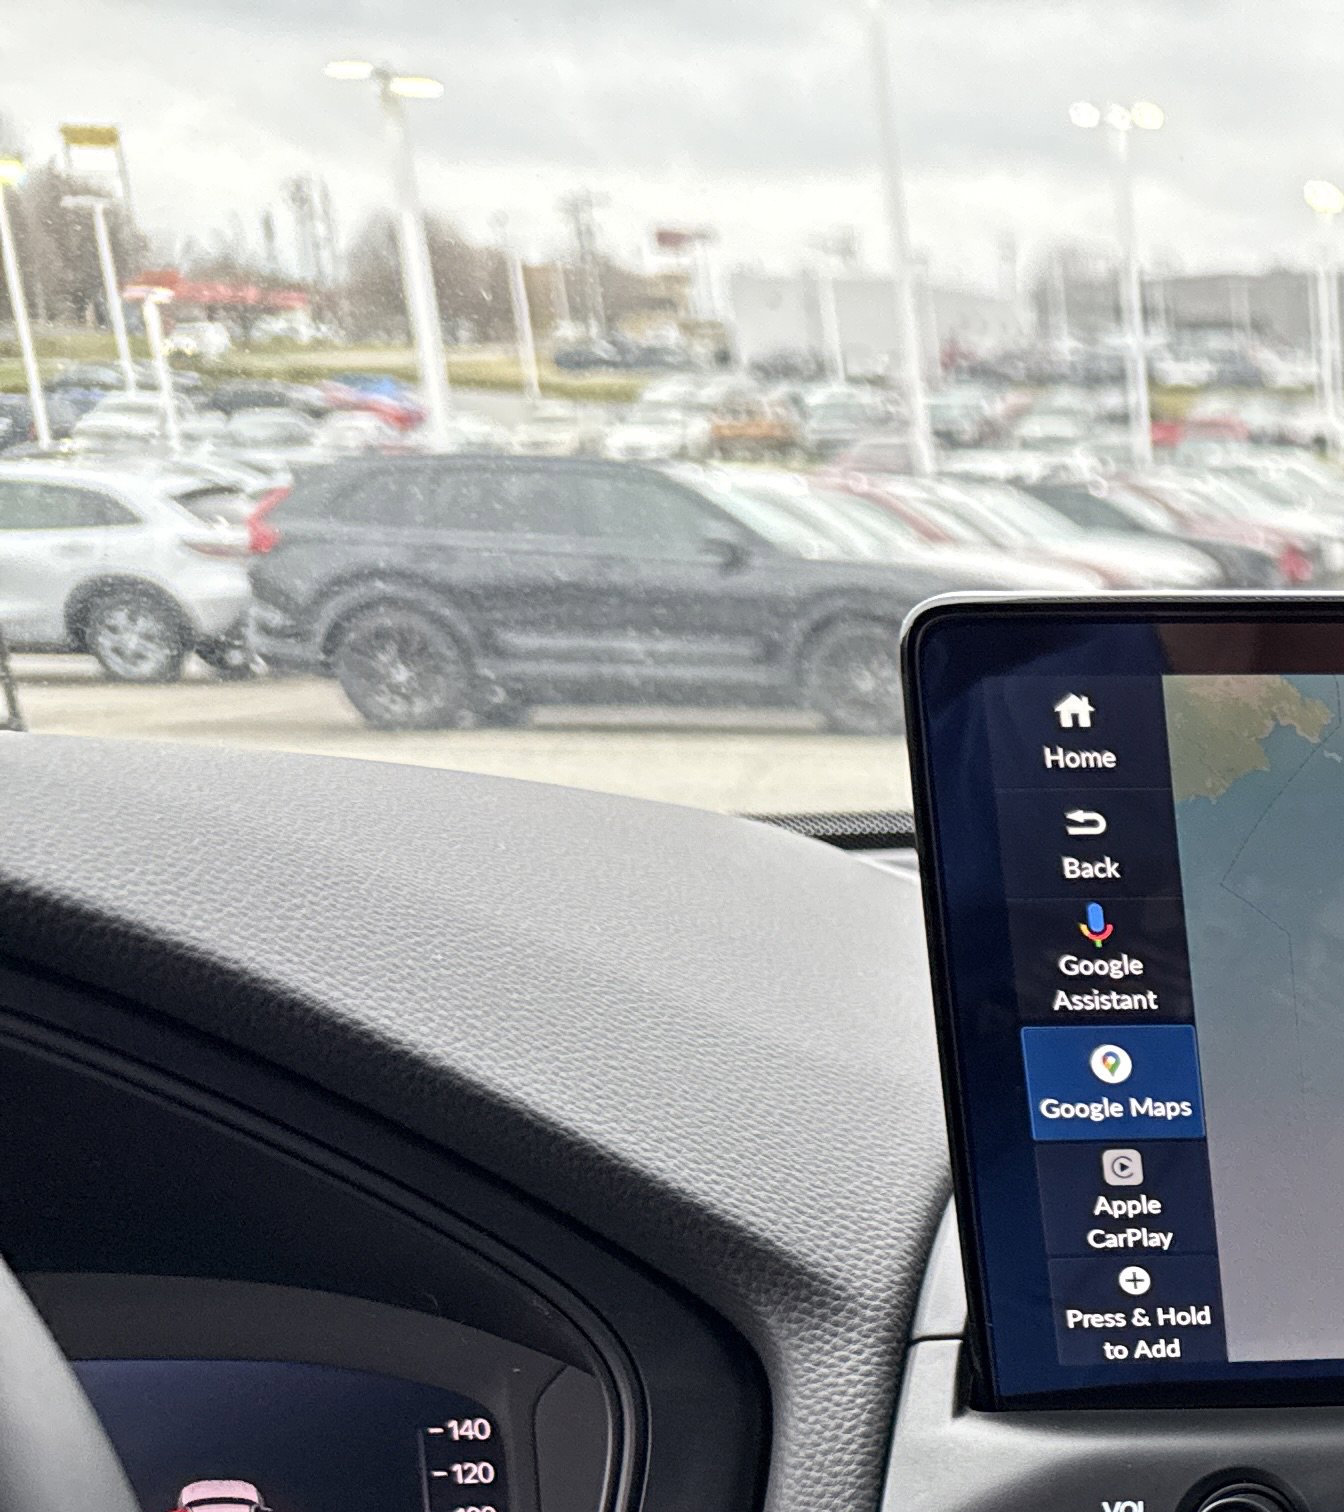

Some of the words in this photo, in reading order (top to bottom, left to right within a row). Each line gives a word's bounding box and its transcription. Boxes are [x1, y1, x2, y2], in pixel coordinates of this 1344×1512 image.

[1043, 745, 1117, 769] Home
[1062, 855, 1121, 879] Back
[1058, 953, 1144, 980] Google
[1052, 988, 1159, 1011] Assistant
[1039, 1096, 1124, 1122] Google
[1128, 1097, 1193, 1121] Maps
[1093, 1194, 1162, 1219] Apple
[1086, 1227, 1174, 1251] CarPlay
[1065, 1309, 1127, 1329] Press
[1130, 1307, 1152, 1327] &
[1156, 1305, 1212, 1326] Hold
[1102, 1341, 1129, 1360] to
[1133, 1337, 1181, 1359] Add
[447, 1417, 492, 1441] 140
[451, 1461, 495, 1485] 120
